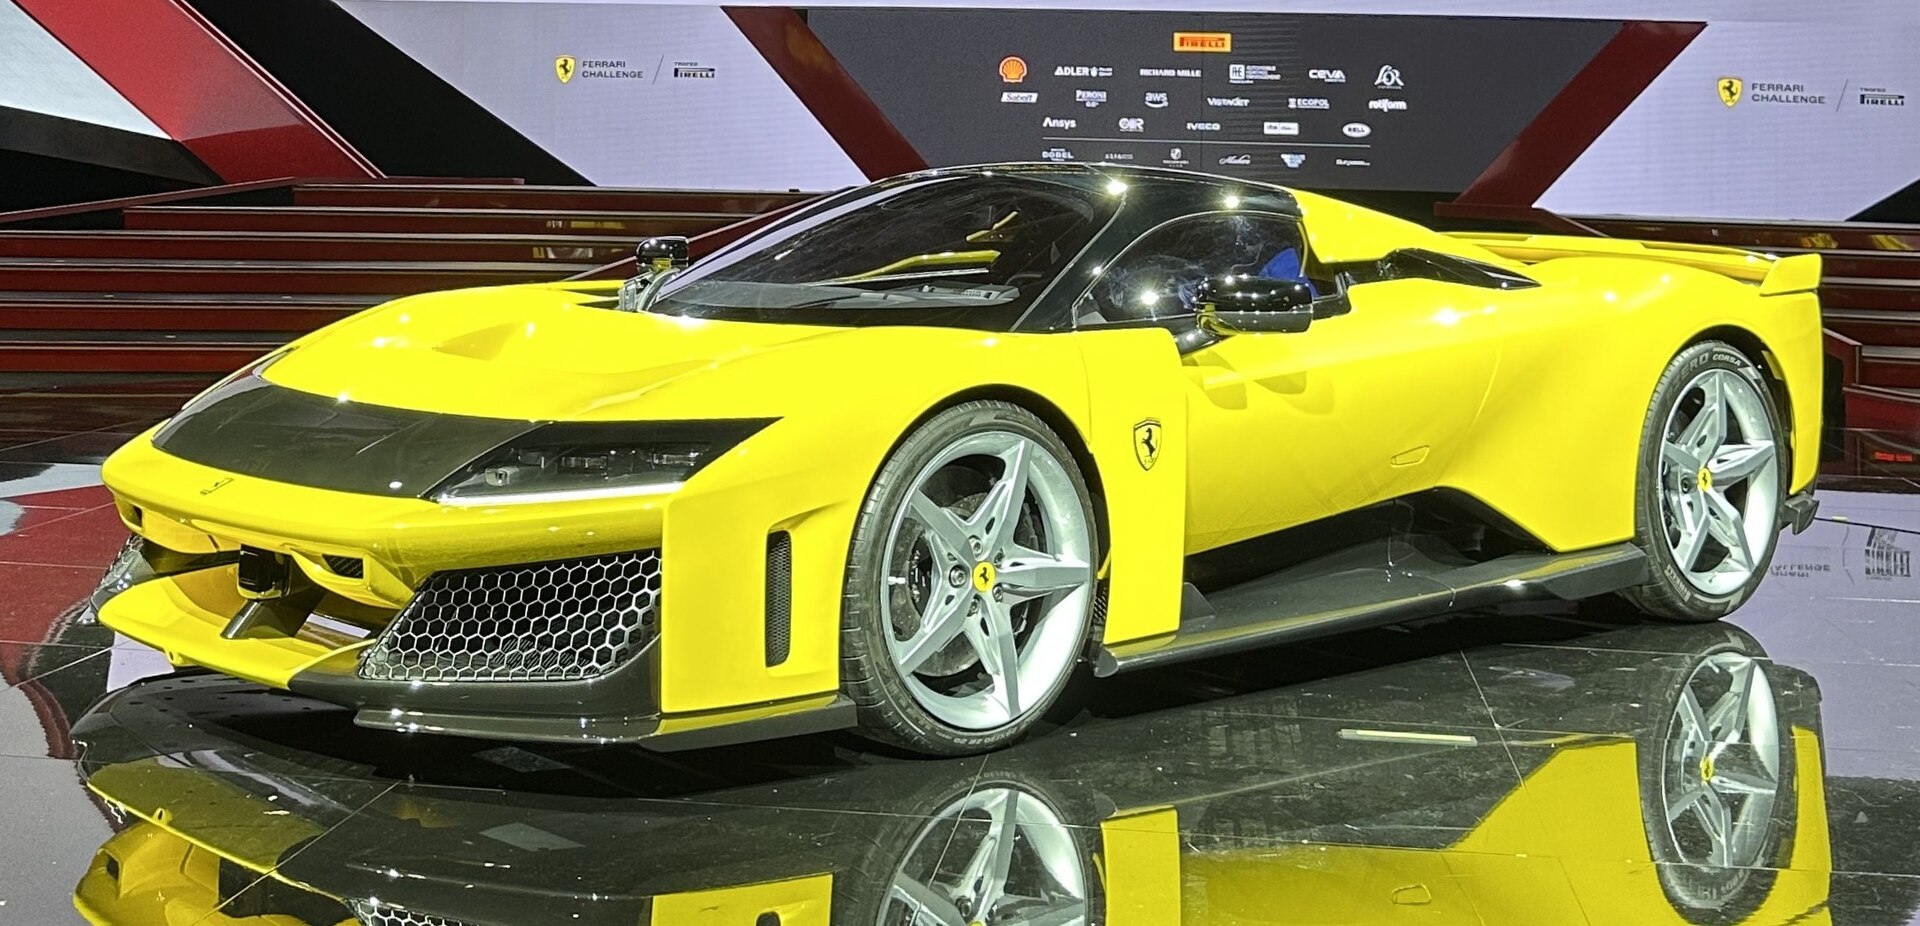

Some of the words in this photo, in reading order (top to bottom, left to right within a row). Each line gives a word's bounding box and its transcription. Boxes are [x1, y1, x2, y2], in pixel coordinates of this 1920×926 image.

[1179, 36, 1225, 48] PIRELLI
[583, 60, 625, 68] FERRARI
[582, 70, 644, 79] CHALLENGE
[674, 68, 715, 78] PIRELLI
[1054, 66, 1089, 76] ADLER
[1139, 69, 1176, 77] RICHARD
[1176, 69, 1202, 77] MILLE
[1308, 69, 1346, 79] CEVA
[1752, 83, 1804, 92] FERRARI
[1075, 90, 1107, 99] PERONI
[1751, 93, 1826, 105] CHALLENGE
[1860, 94, 1905, 106] PIRELLI
[1043, 117, 1076, 129] Ansys
[1186, 122, 1221, 131] IVECO
[1713, 354, 1741, 366] CORSA
